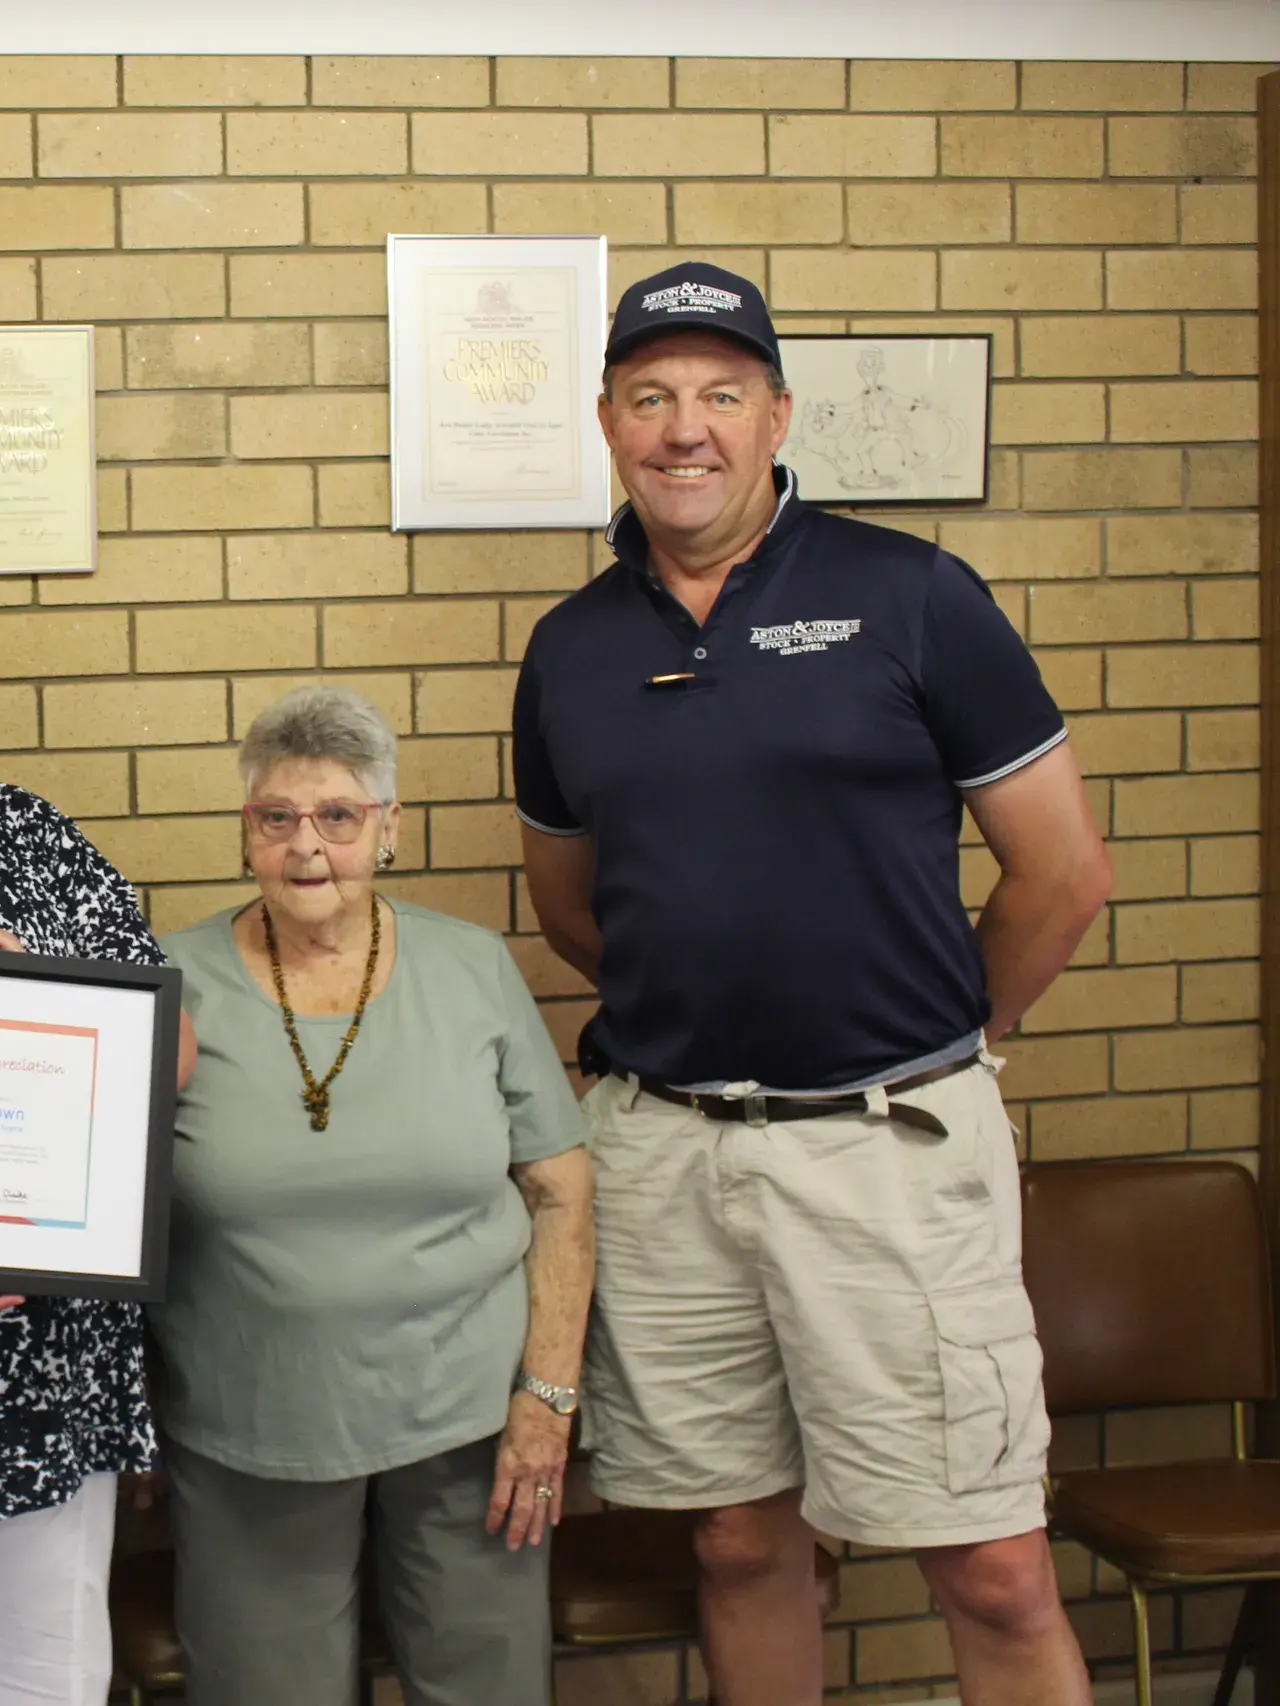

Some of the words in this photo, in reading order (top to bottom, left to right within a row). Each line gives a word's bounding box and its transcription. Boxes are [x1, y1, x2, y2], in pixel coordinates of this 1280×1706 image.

[689, 298, 735, 312] PROPERTY
[442, 357, 550, 383] COMMUNITY
[471, 381, 536, 405] AWARD
[751, 627, 792, 641] ASTON
[809, 621, 851, 633] JOYCE
[759, 640, 791, 650] STOCK
[801, 633, 851, 645] PROPERTY
[780, 643, 828, 655] GRENFELL
